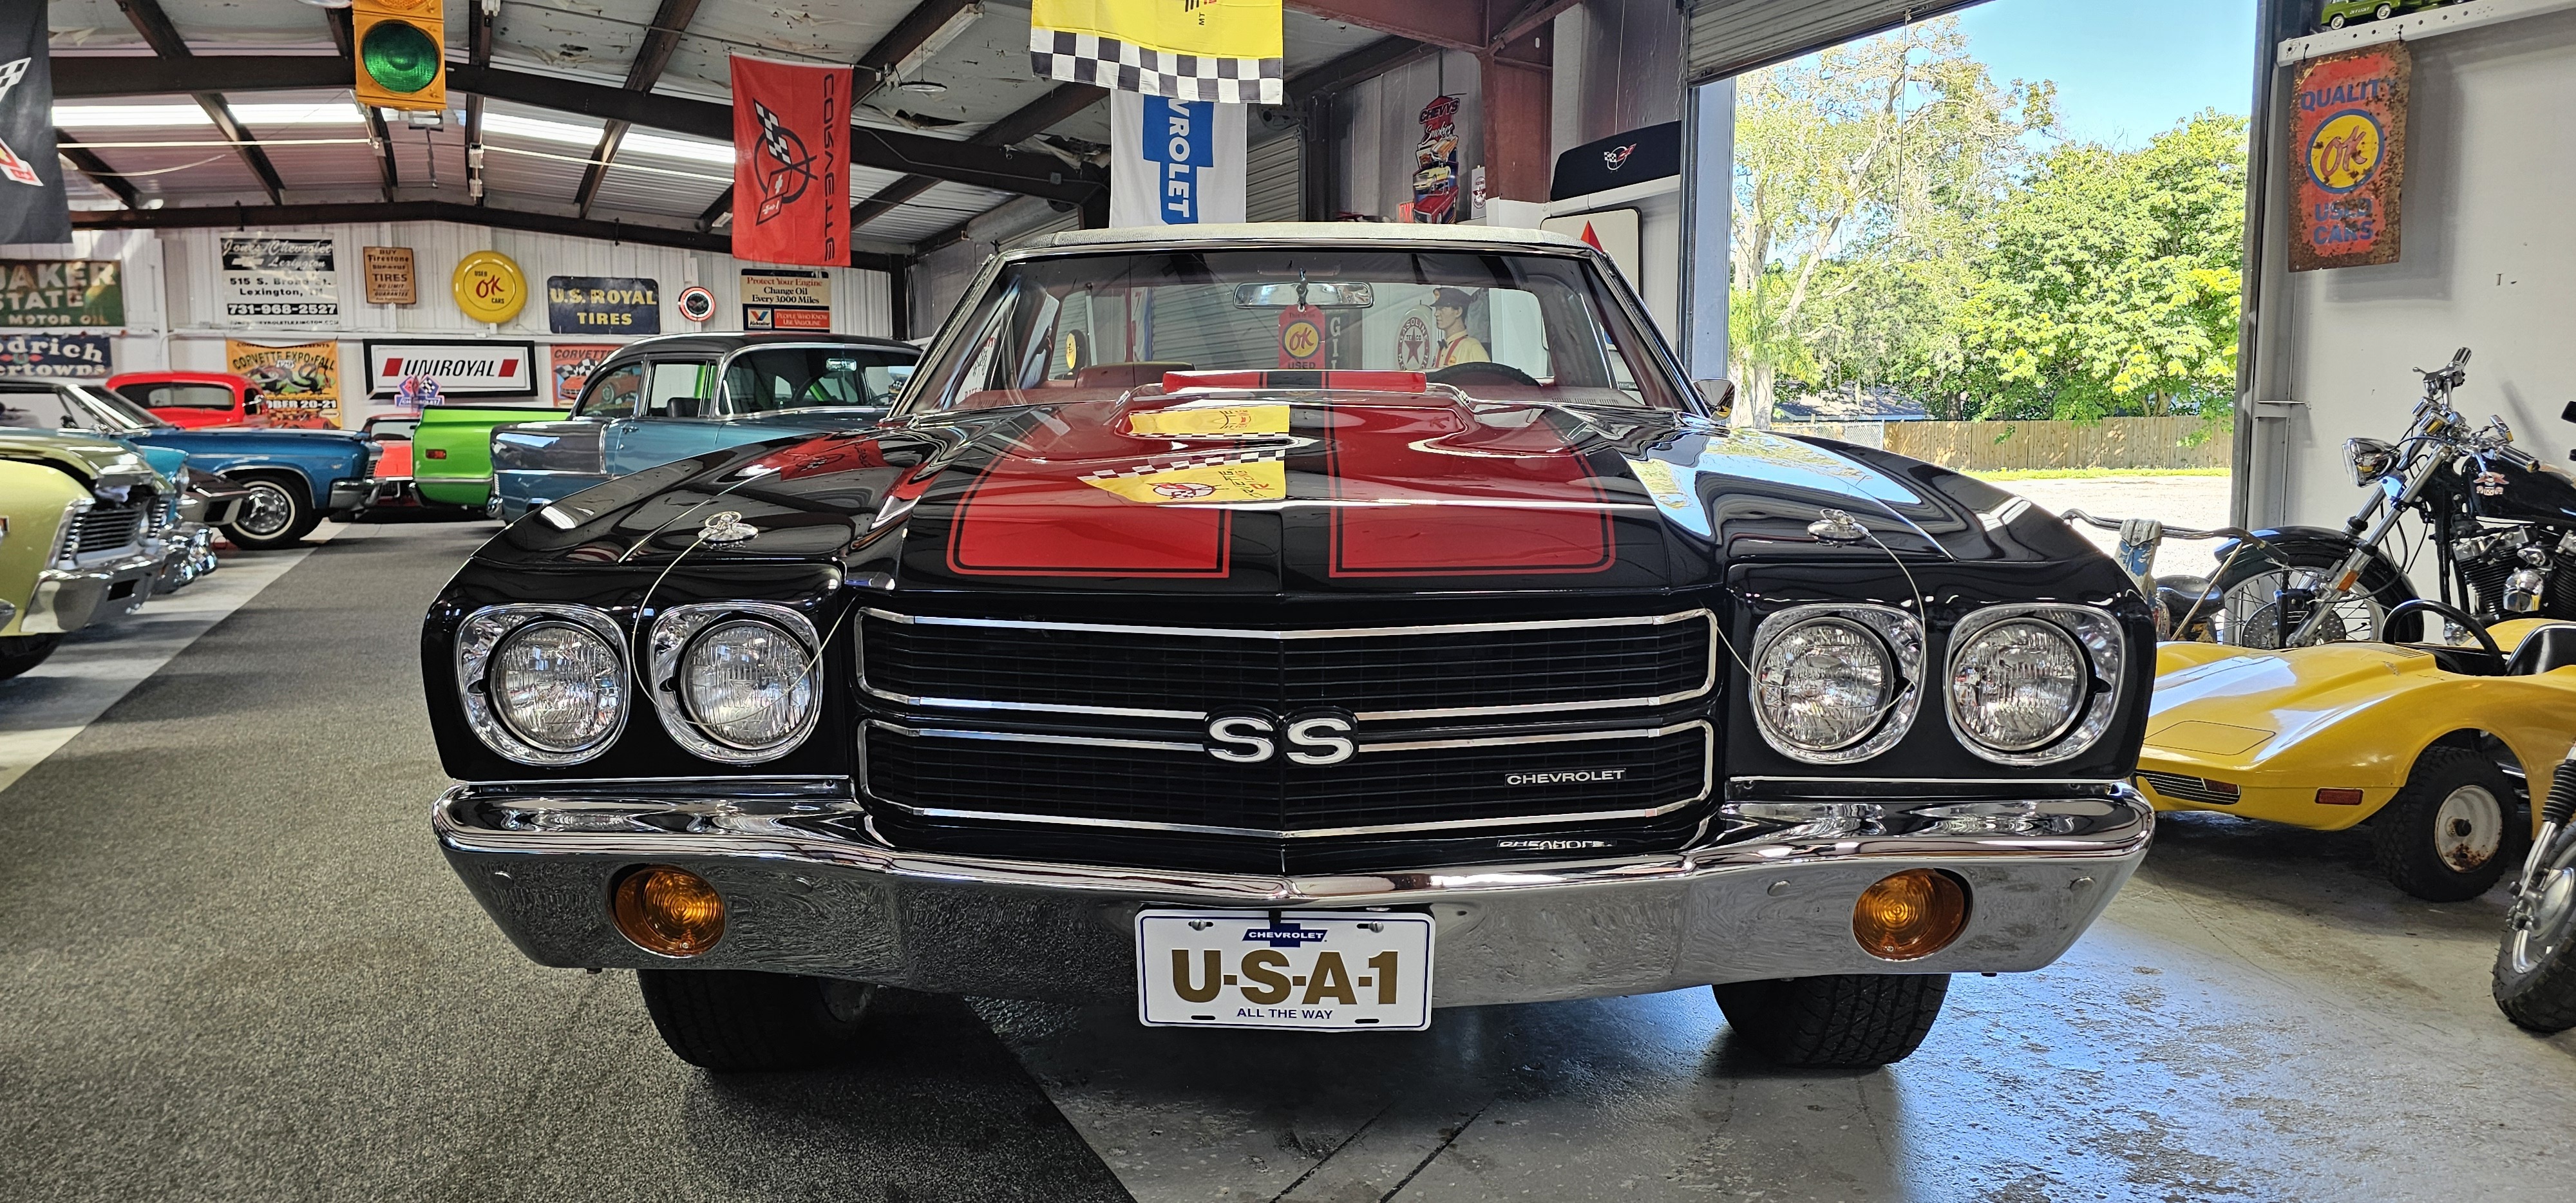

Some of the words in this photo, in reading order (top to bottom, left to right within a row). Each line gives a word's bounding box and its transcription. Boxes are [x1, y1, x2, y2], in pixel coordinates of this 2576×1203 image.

[2320, 126, 2367, 177] OK
[268, 239, 333, 255] Chevrolet
[268, 256, 326, 270] Lexington
[372, 273, 407, 282] TIRES
[747, 277, 775, 285] Protect
[795, 279, 822, 287] Engine
[240, 288, 303, 297] Lexington,
[475, 274, 505, 298] OK
[764, 287, 794, 295] Change
[549, 287, 586, 304] U.S.
[591, 289, 656, 305] ROYAL
[752, 294, 774, 303] Every
[798, 296, 820, 304] Miles
[229, 304, 336, 314] 731-968-2527
[8, 314, 71, 325] MOTOR
[80, 315, 109, 325] OIL
[577, 312, 632, 325] TIRES
[1399, 317, 1429, 343] GASOLINE
[1289, 327, 1314, 351] OK
[232, 351, 282, 370] CORVETTE
[404, 359, 495, 377] UNIROYAL
[266, 400, 298, 409] OBER
[301, 400, 336, 409] 20-21
[1208, 717, 1355, 766] SS
[1506, 770, 1625, 785] CHEVROLET
[1248, 931, 1325, 940] CHEVROLET
[1171, 949, 1399, 1005] U-S-A-1
[1236, 1008, 1265, 1018] ALL
[1268, 1009, 1298, 1019] THE
[1301, 1009, 1334, 1020] WAY
